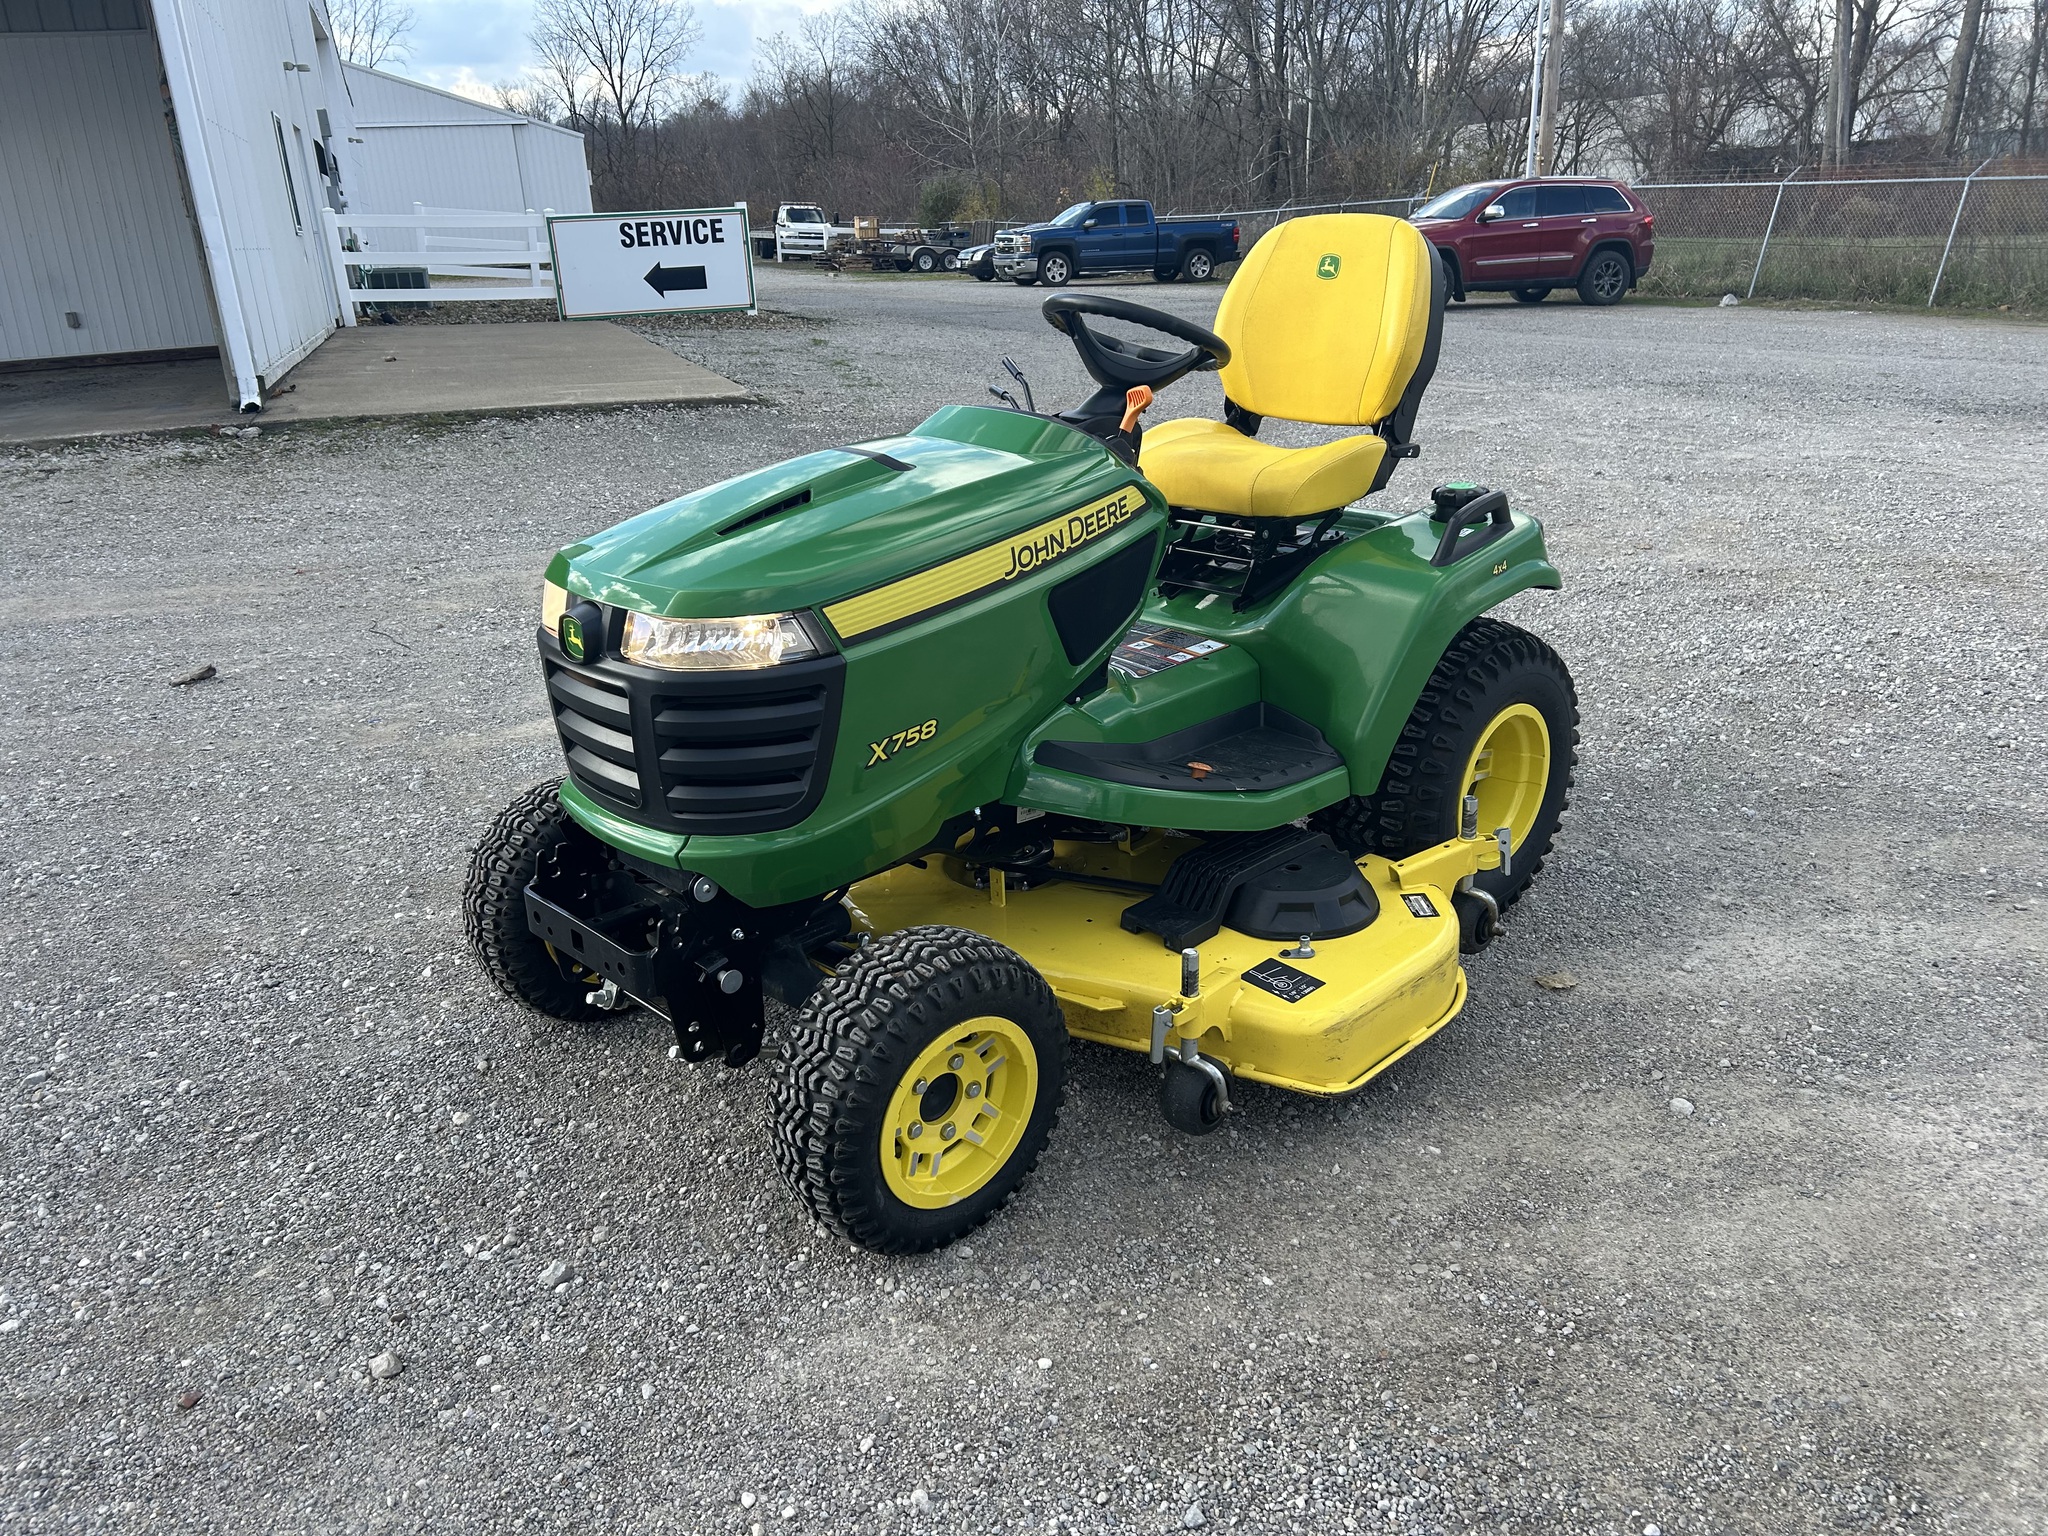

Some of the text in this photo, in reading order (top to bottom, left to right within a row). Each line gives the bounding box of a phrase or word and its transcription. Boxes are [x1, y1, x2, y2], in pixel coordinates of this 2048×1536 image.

[619, 218, 725, 248] SERVICE
[1004, 494, 1130, 578] JOHN DEERE
[1492, 559, 1507, 575] 4x4
[865, 718, 939, 768] X758
